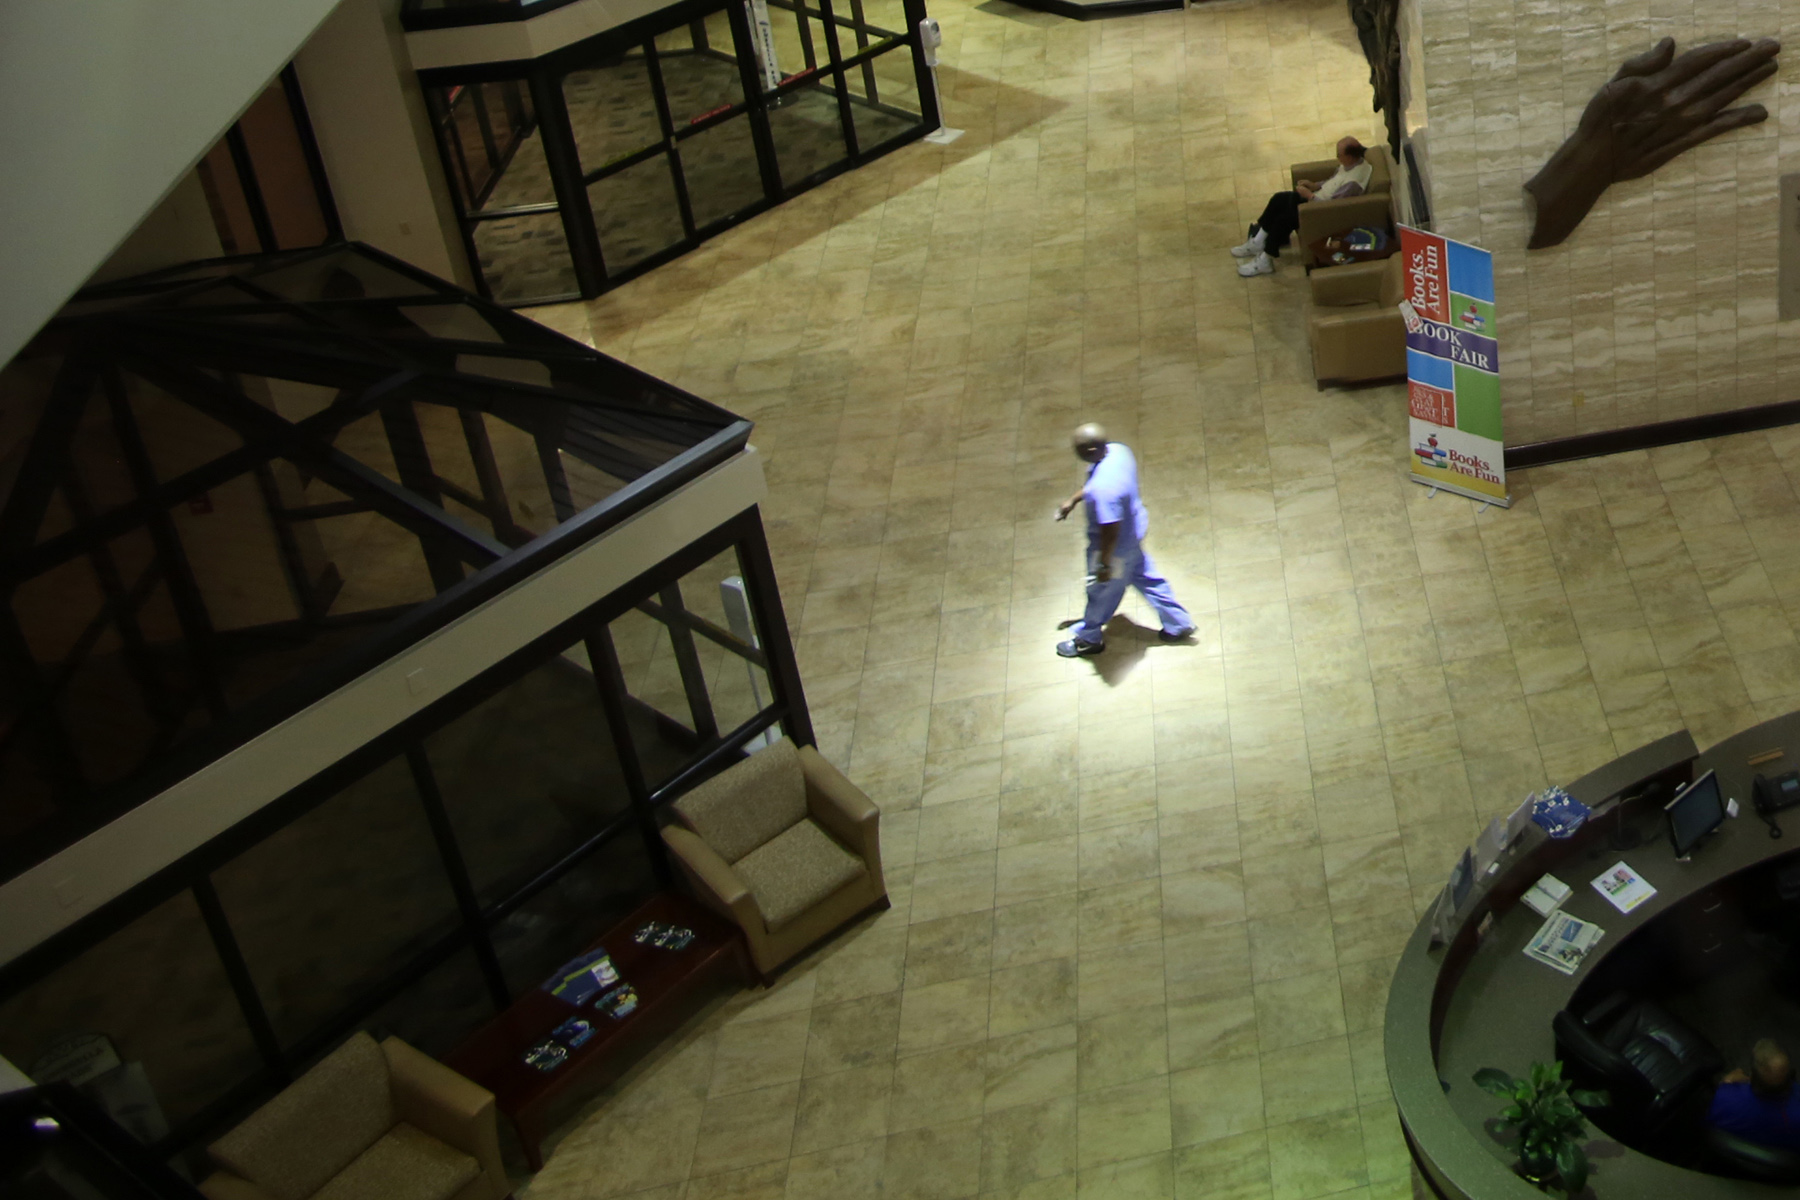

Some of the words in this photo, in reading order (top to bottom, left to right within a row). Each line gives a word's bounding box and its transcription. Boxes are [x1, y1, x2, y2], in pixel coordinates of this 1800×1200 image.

[1425, 245, 1438, 281] Fun
[1427, 281, 1440, 315] Are
[1450, 344, 1490, 369] FAIR
[1450, 461, 1473, 477] Are
[1475, 467, 1500, 484] Fun
